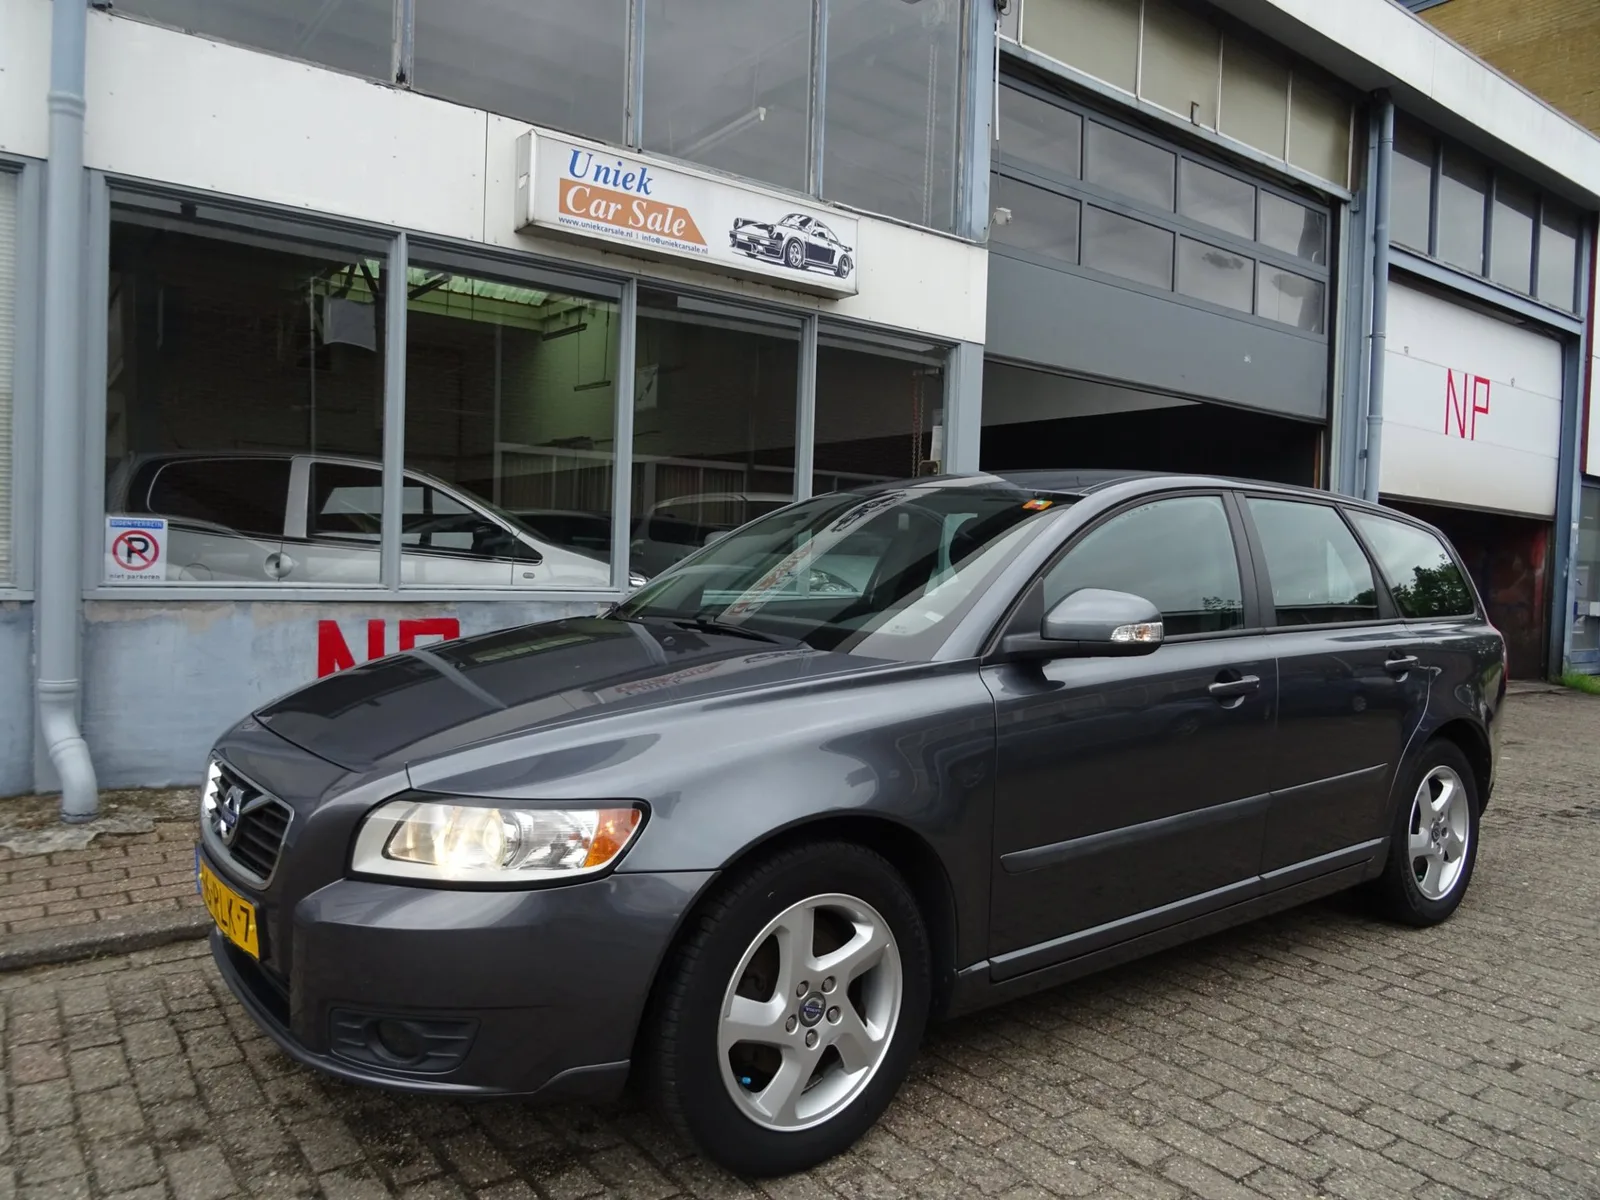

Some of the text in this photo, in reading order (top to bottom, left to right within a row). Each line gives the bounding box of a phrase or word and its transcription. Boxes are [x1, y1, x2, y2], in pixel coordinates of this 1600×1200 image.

[569, 149, 653, 194] Uniek
[567, 186, 686, 236] Car Sale
[558, 216, 708, 255] www.uniekcarsale.nl info@uniekcarsale.nl
[1445, 367, 1491, 442] NP
